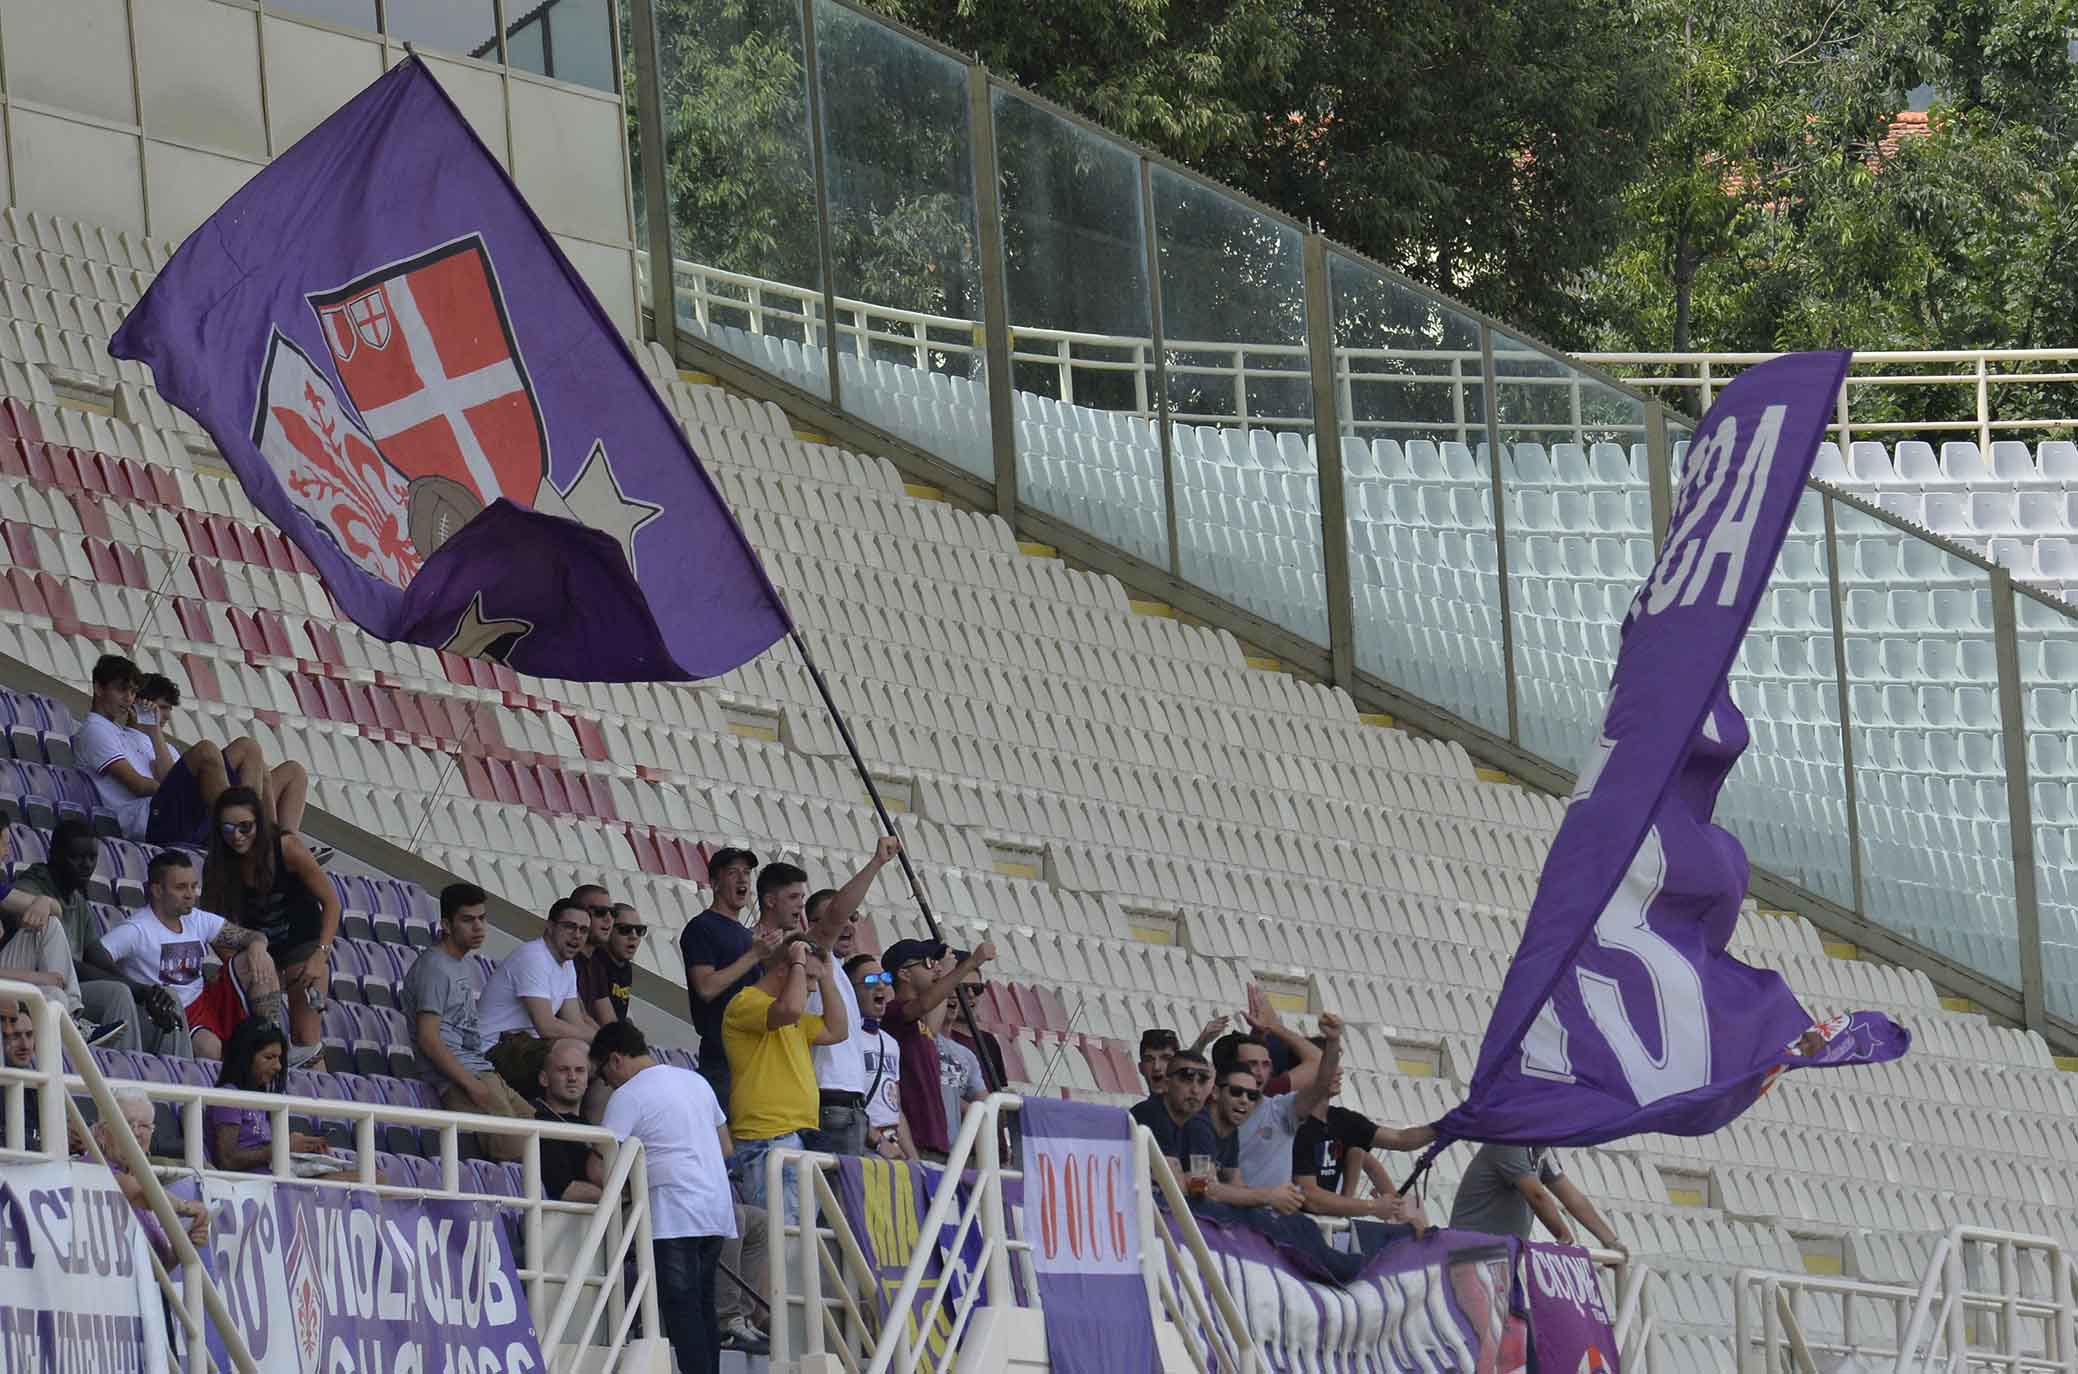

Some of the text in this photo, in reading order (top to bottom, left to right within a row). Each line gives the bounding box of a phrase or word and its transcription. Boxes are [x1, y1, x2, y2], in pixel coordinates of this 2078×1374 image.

[28, 1186, 134, 1279] CLUB
[315, 1206, 518, 1330] VIOLA CLUB
